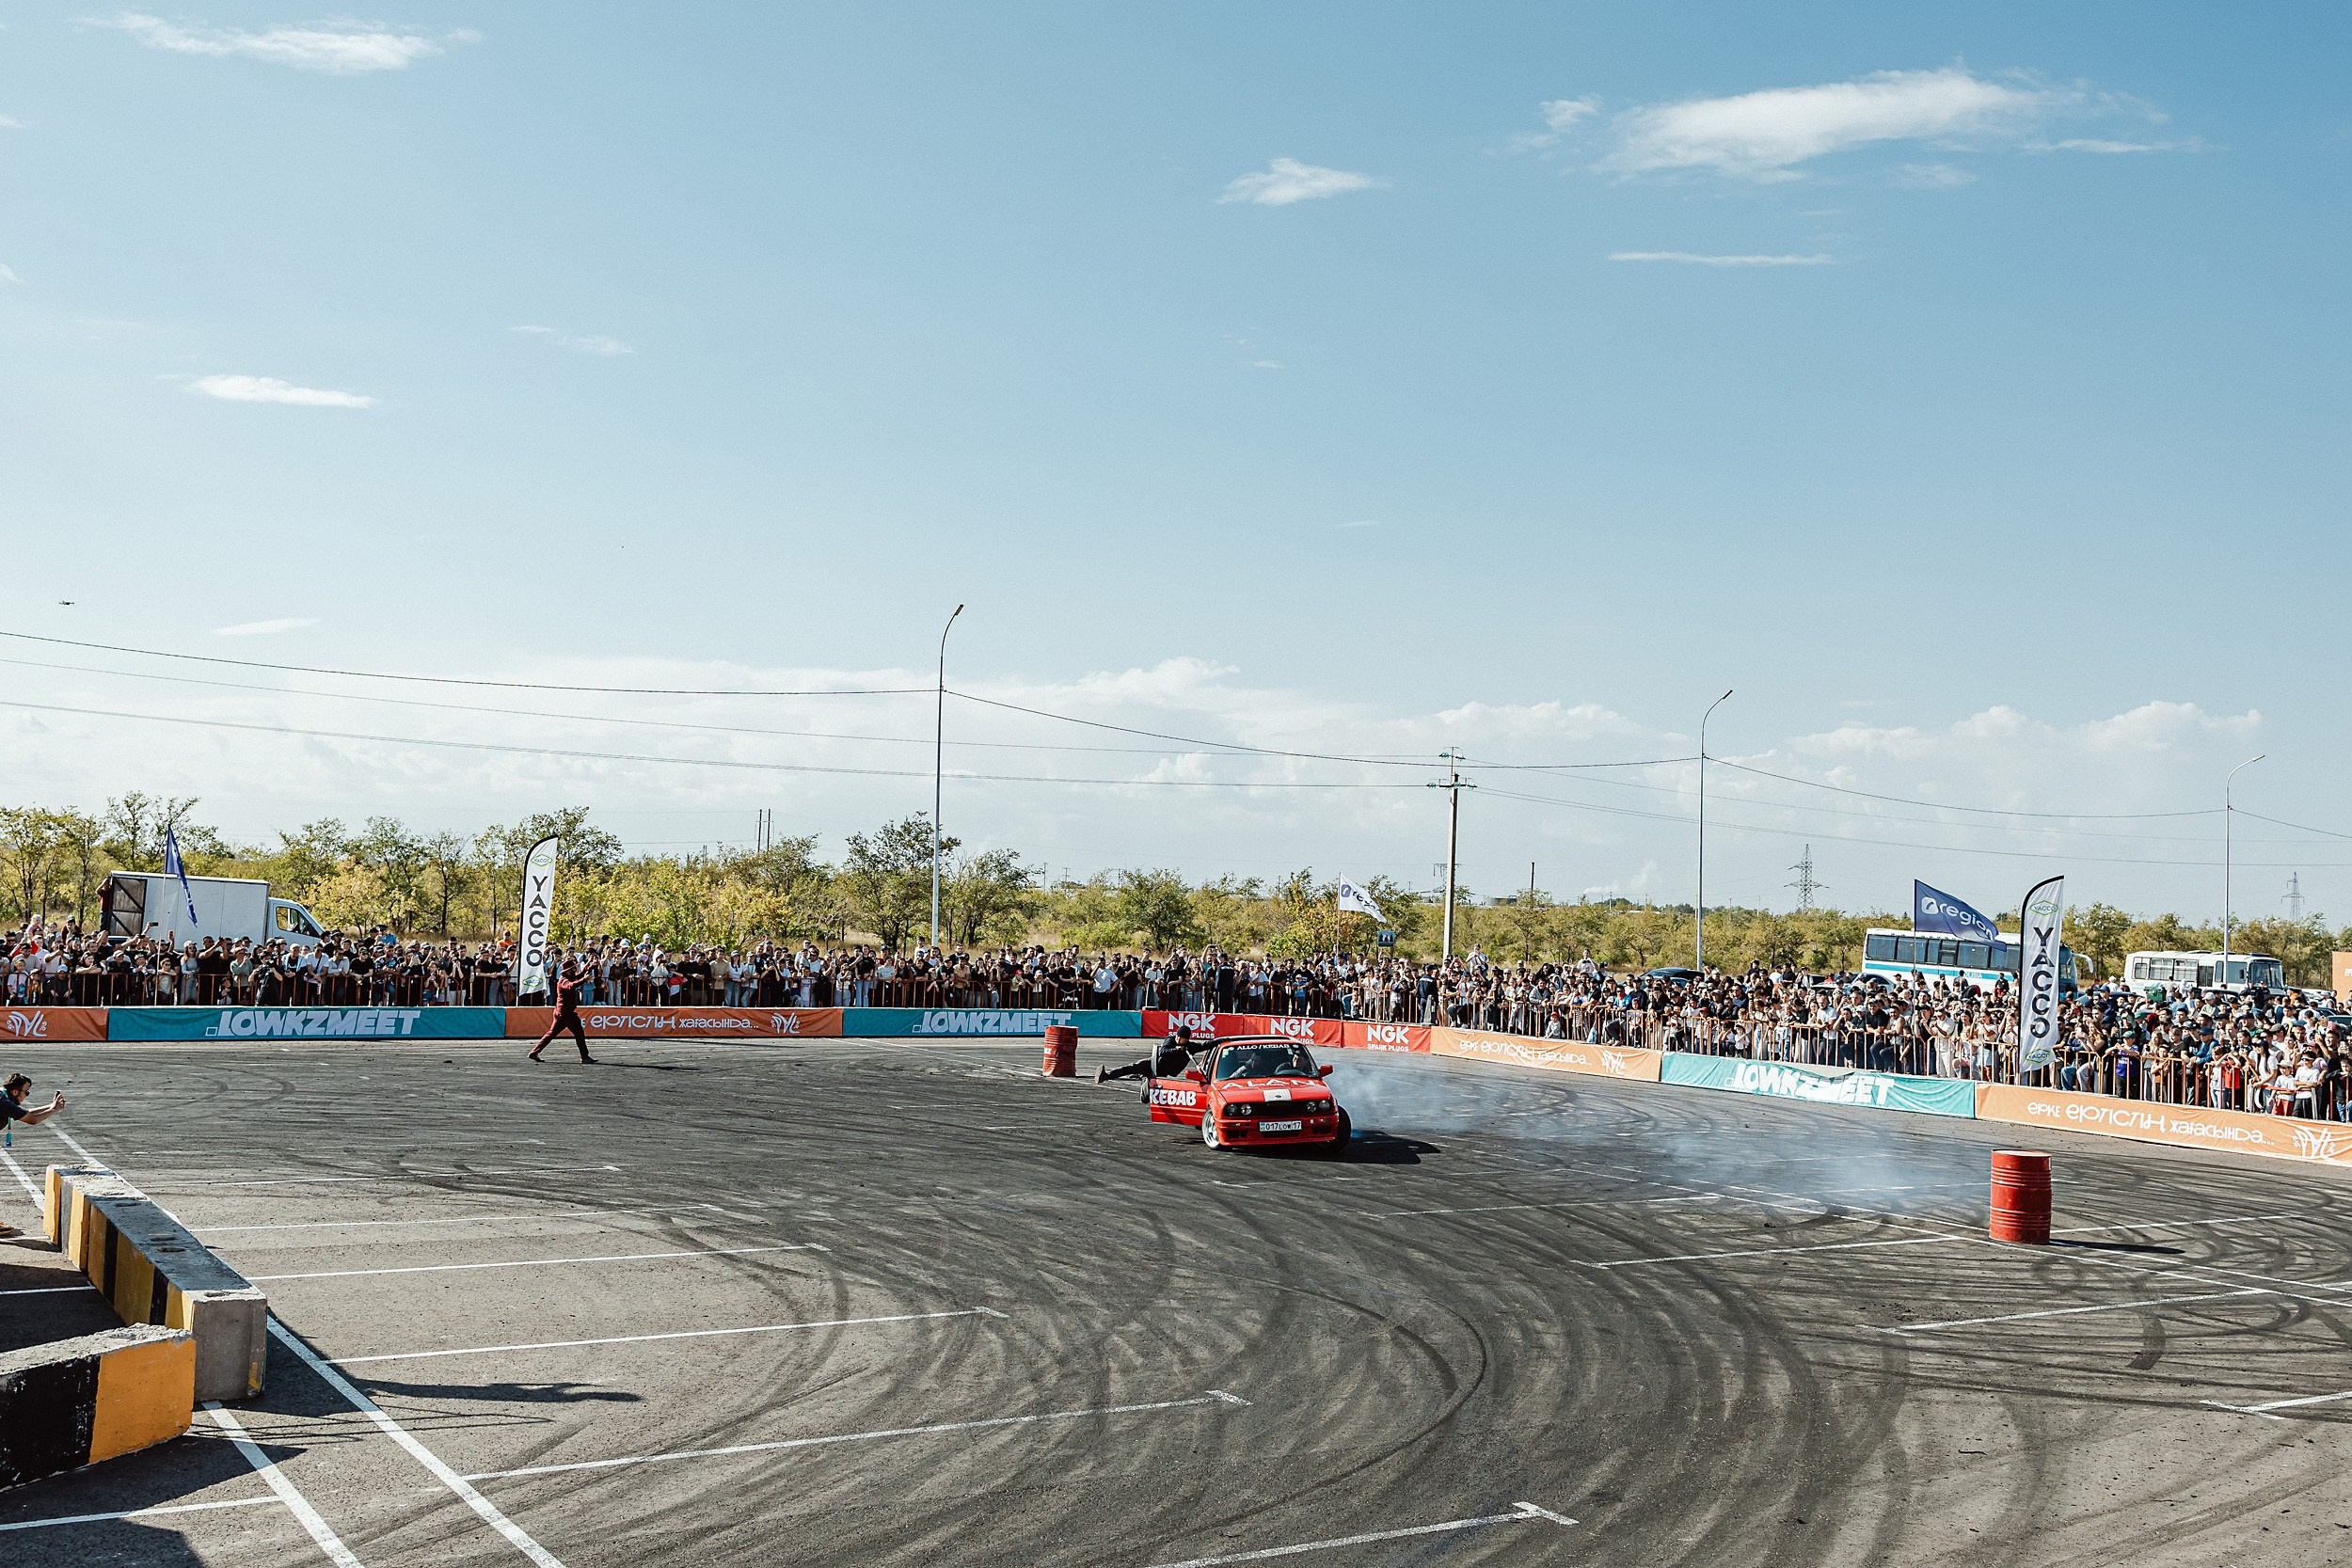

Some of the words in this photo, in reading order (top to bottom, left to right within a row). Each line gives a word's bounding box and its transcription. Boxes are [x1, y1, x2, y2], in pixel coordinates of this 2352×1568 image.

[526, 876, 548, 967] YACCO
[1939, 903, 1994, 941] region
[2030, 927, 2055, 1039] YACCO
[1168, 1013, 1216, 1032] NGK
[1270, 1018, 1315, 1037] NGK
[1367, 1024, 1409, 1045] NGK
[1222, 1079, 1316, 1089] ALAN
[1150, 1088, 1196, 1106] KEBAB
